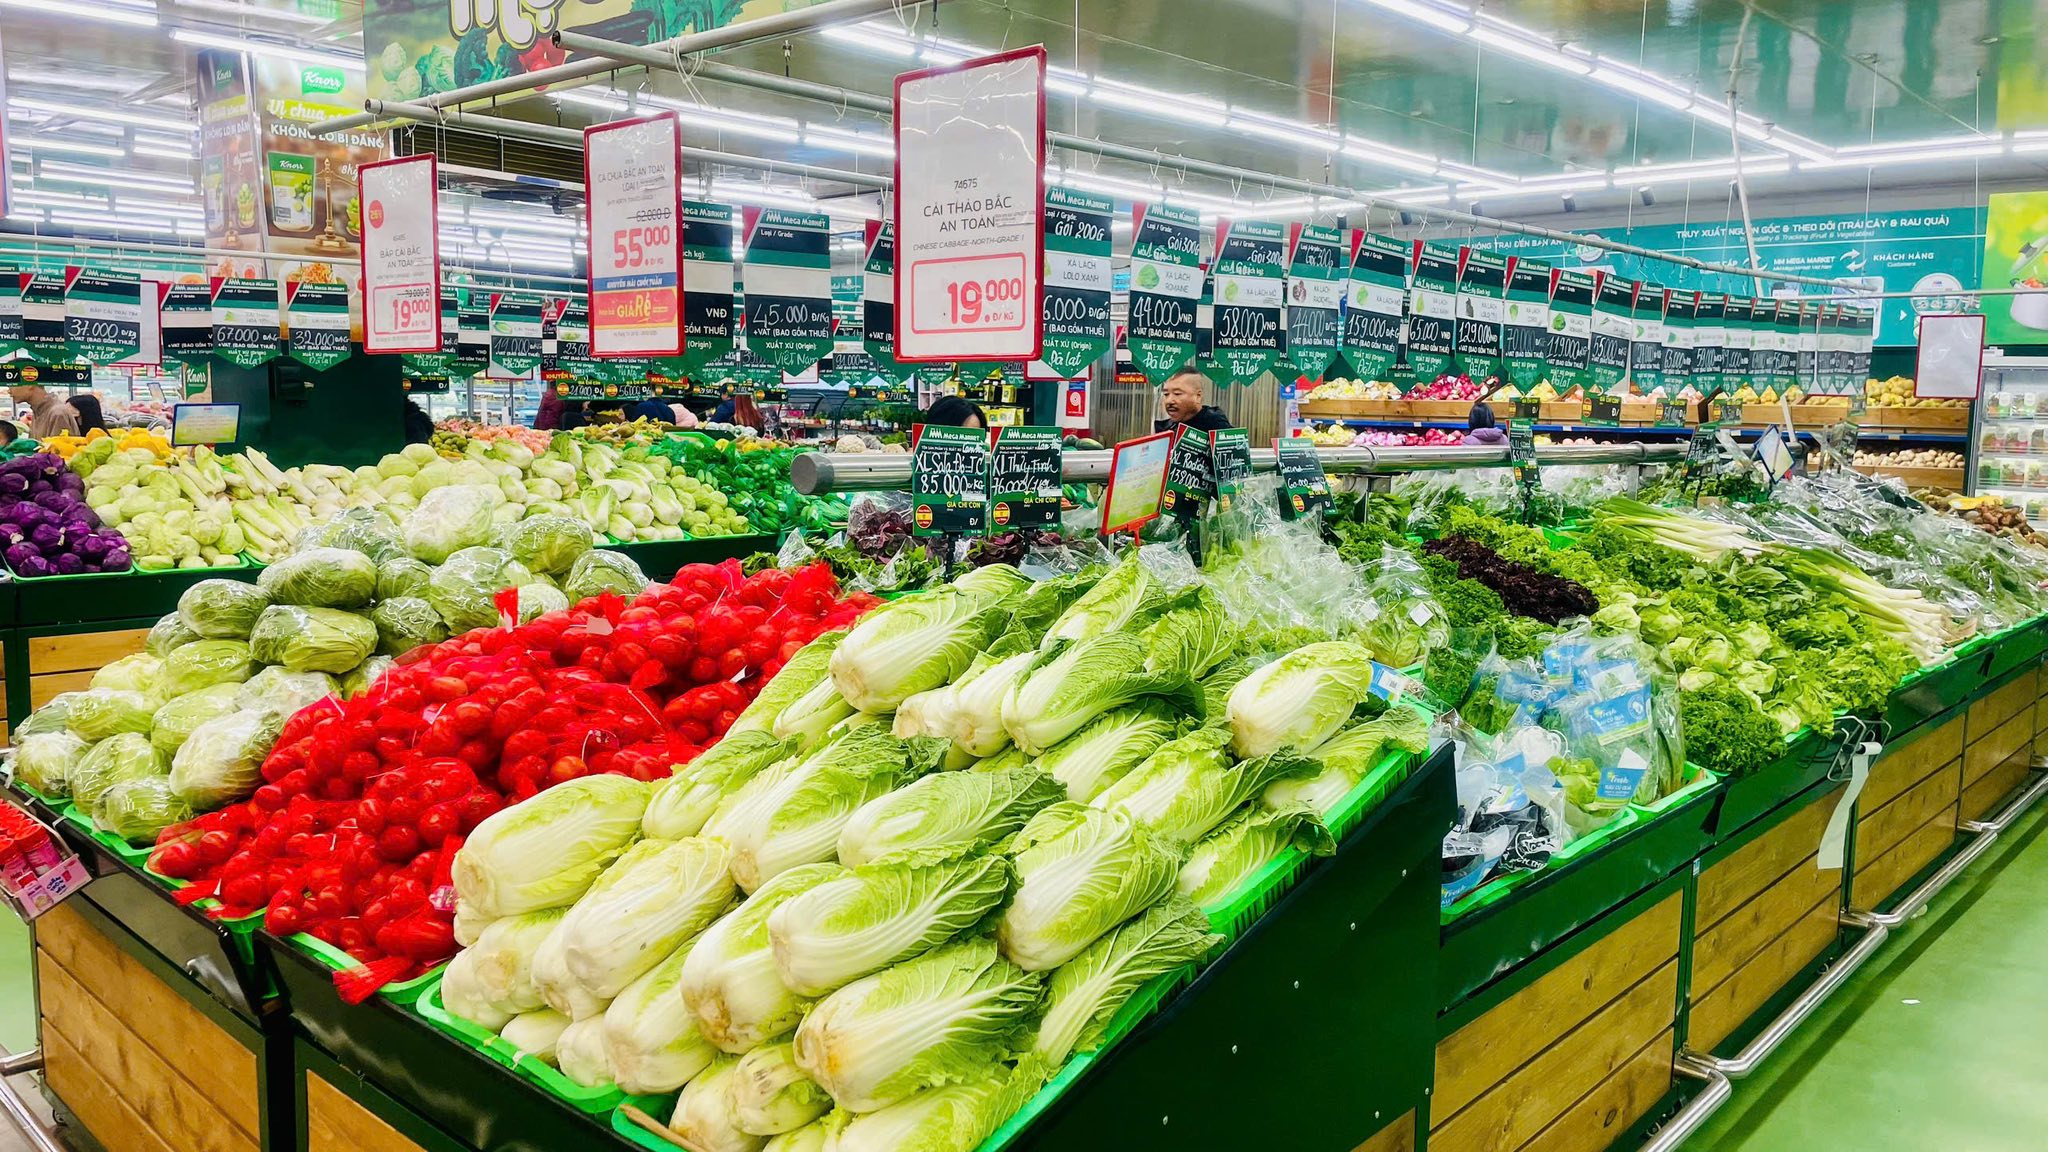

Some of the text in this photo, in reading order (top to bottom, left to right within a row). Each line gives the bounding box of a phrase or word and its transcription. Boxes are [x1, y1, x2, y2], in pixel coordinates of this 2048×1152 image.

[303, 71, 341, 87] Knorr
[290, 102, 325, 120] chua
[280, 160, 304, 170] Knorr
[607, 171, 623, 182] CHUA
[638, 167, 647, 176] AN
[954, 178, 978, 190] 74675
[682, 204, 699, 216] ega
[923, 193, 1012, 217] CẢI THẢO BẮC
[939, 221, 956, 233] AN
[961, 215, 995, 230] TOÀN
[1676, 230, 1700, 239] TRUY
[1701, 225, 1727, 237] XUẤT
[1728, 227, 1759, 236] NGUN
[1761, 222, 1780, 234] GỐC
[1792, 223, 1817, 232] THEO
[1865, 217, 1887, 229] CÂY
[1900, 218, 1921, 227] RAU
[913, 241, 938, 251] CHINESE
[1786, 257, 1806, 265] MEGA
[1806, 256, 1836, 264] MARKET
[1873, 250, 1934, 262] KHÁCH HÀNG
[705, 307, 727, 318] VNĐ
[752, 302, 809, 327] 45.000
[1133, 296, 1180, 327] 44.000
[703, 324, 728, 337] THUẾ)
[1049, 323, 1066, 334] (BAO
[1085, 323, 1105, 338] THUẾ)
[1220, 307, 1265, 339] 58.000
[217, 326, 260, 342] 67.000
[753, 327, 771, 336] +VAT
[772, 327, 794, 338] (BAO
[794, 325, 809, 337] GỒM
[809, 326, 829, 339] THUẾ)
[1148, 328, 1162, 338] (BAO
[920, 474, 968, 494] 85.000
[1611, 774, 1630, 784] Fresh
